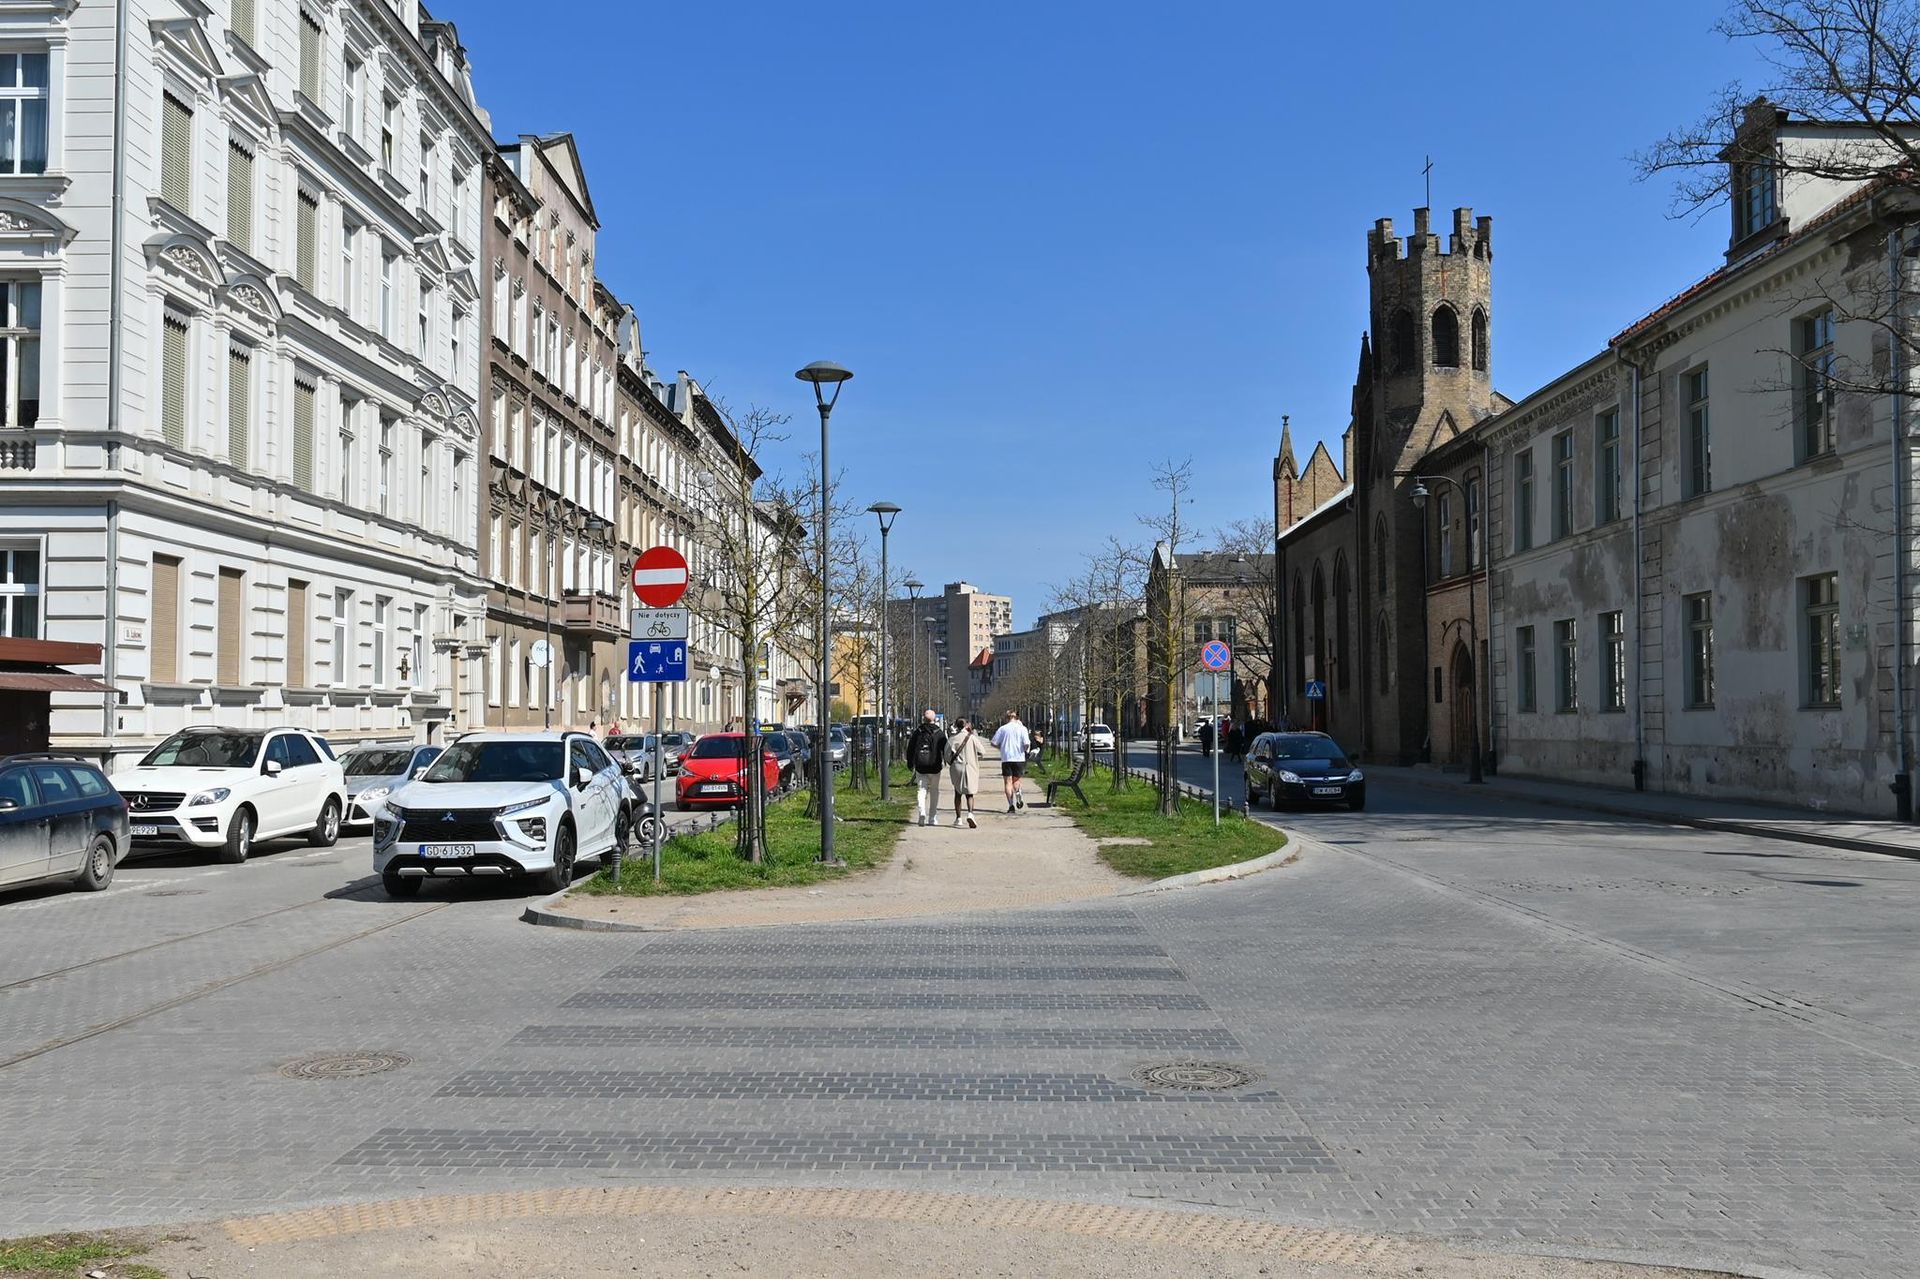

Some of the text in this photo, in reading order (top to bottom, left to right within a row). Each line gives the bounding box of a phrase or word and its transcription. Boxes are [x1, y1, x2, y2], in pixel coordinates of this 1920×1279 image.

[655, 611, 680, 619] dotyczy
[426, 845, 472, 856] GD 6J532
